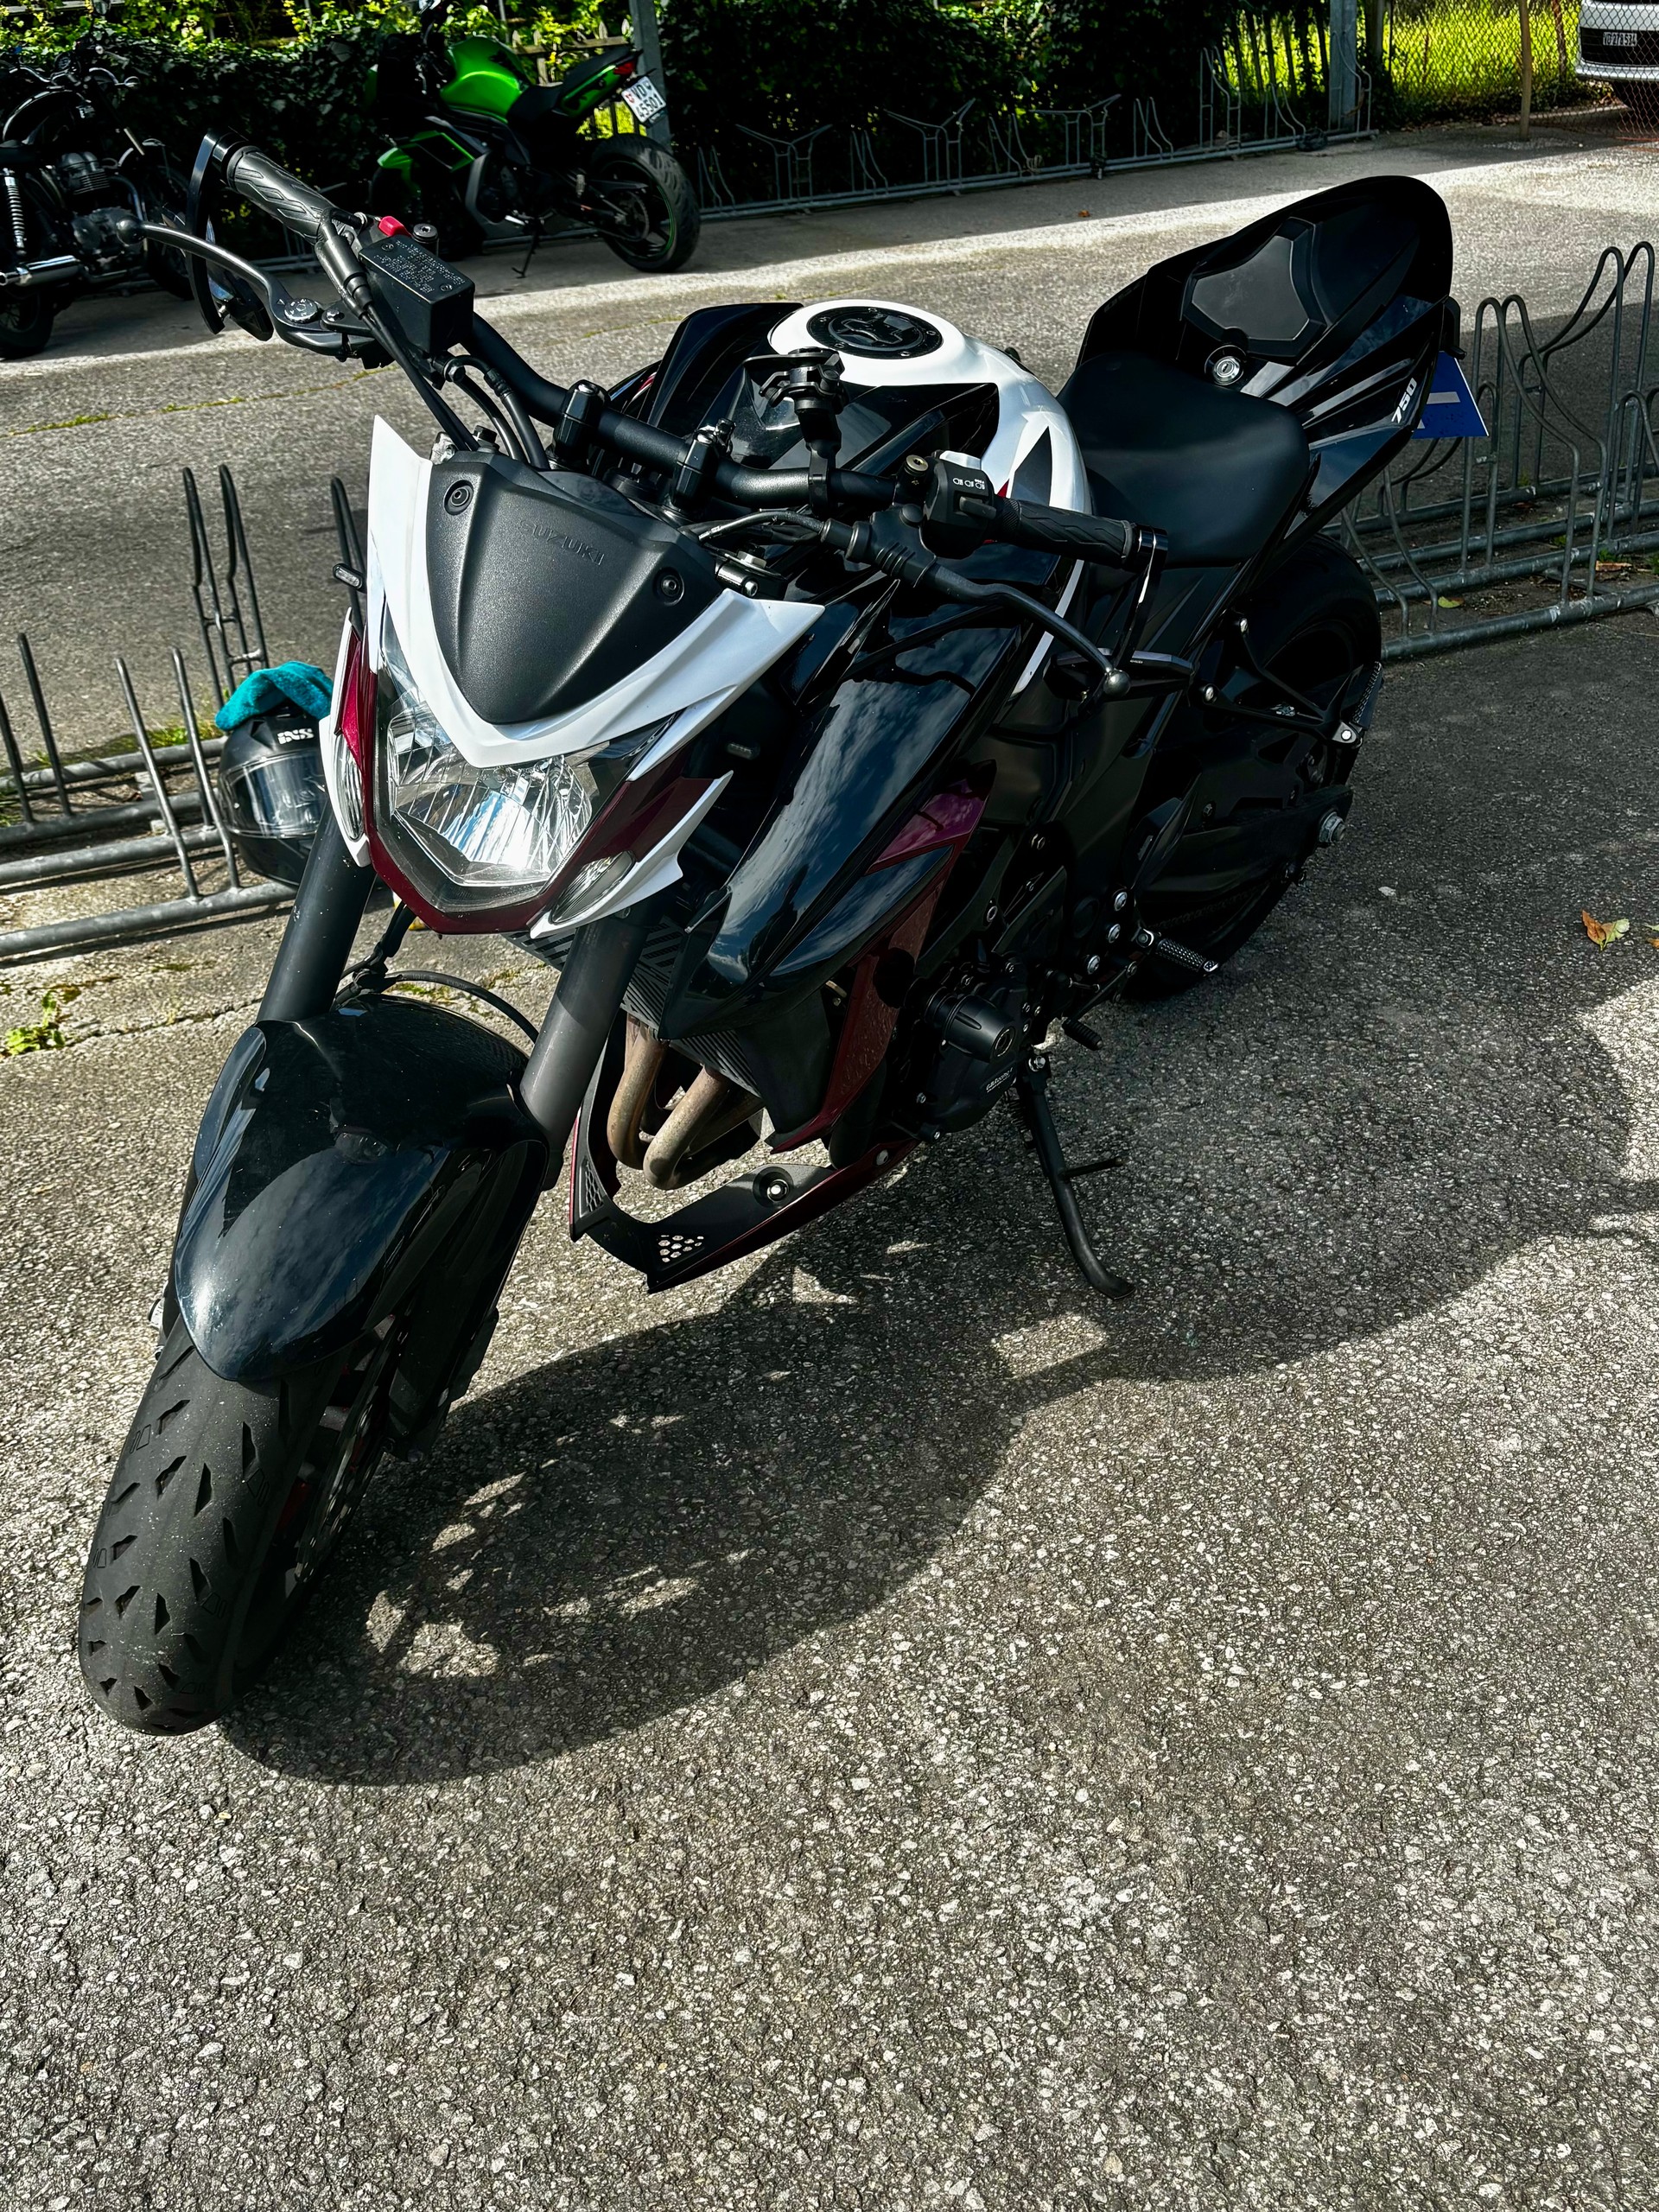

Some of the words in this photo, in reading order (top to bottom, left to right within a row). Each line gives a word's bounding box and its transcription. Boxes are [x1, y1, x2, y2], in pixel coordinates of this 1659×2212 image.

[636, 93, 663, 118] 45501
[1391, 378, 1417, 423] 750
[518, 518, 605, 566] SUZUKI
